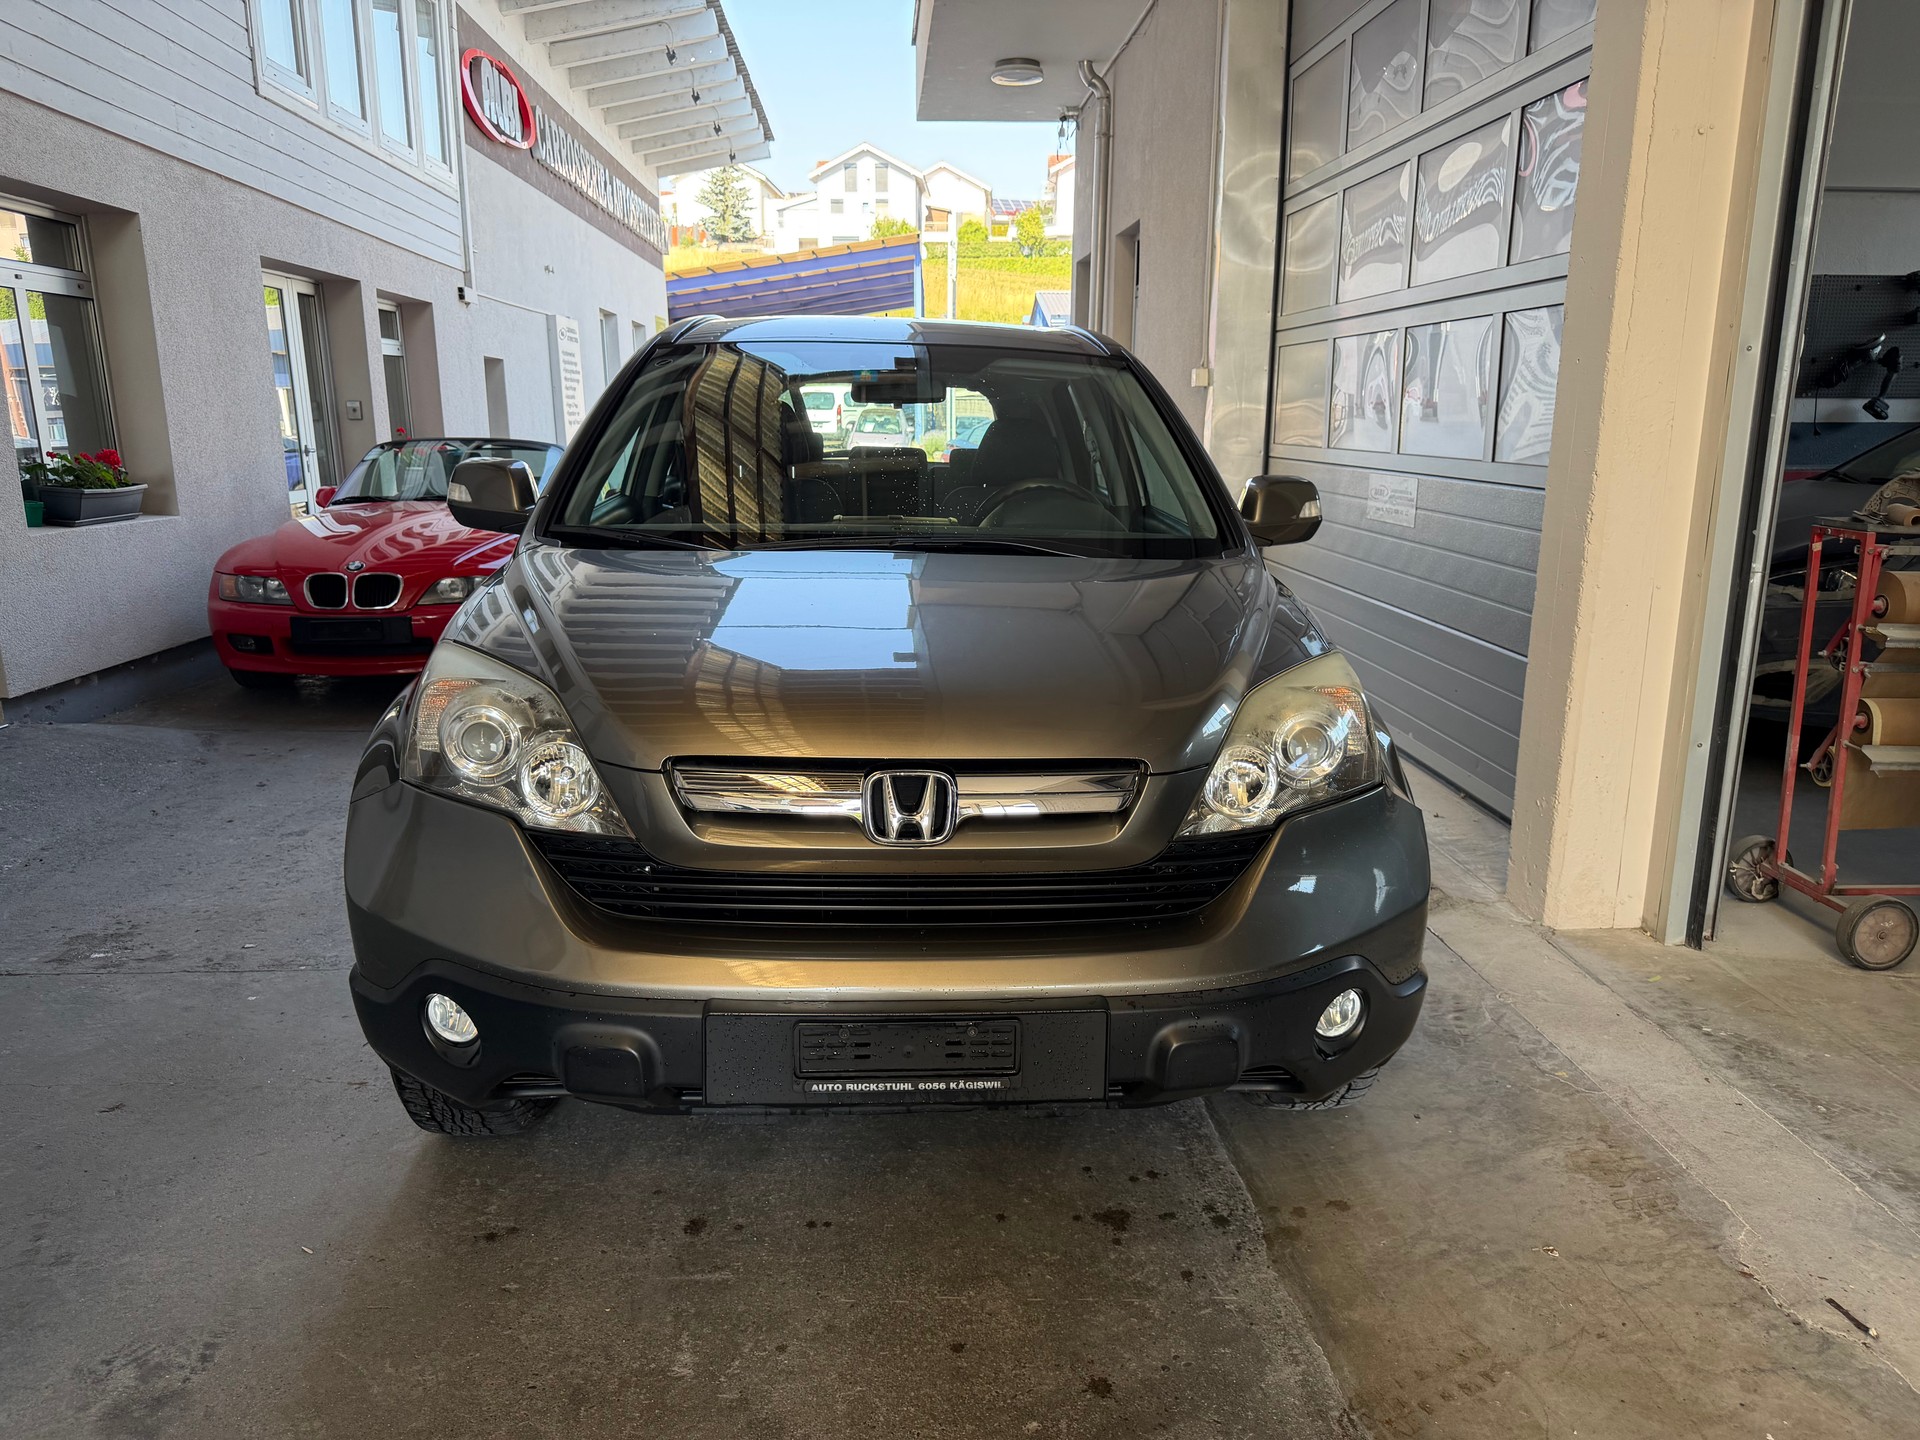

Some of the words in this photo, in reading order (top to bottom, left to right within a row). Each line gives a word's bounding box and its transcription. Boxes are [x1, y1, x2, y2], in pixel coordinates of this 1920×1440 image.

[535, 104, 607, 209] CARROSSERIE
[811, 1083, 842, 1091] AUTO
[846, 1083, 914, 1091] RUCKSTUHL
[918, 1082, 946, 1090] 6056
[949, 1080, 1004, 1090] KÄGISWIL
